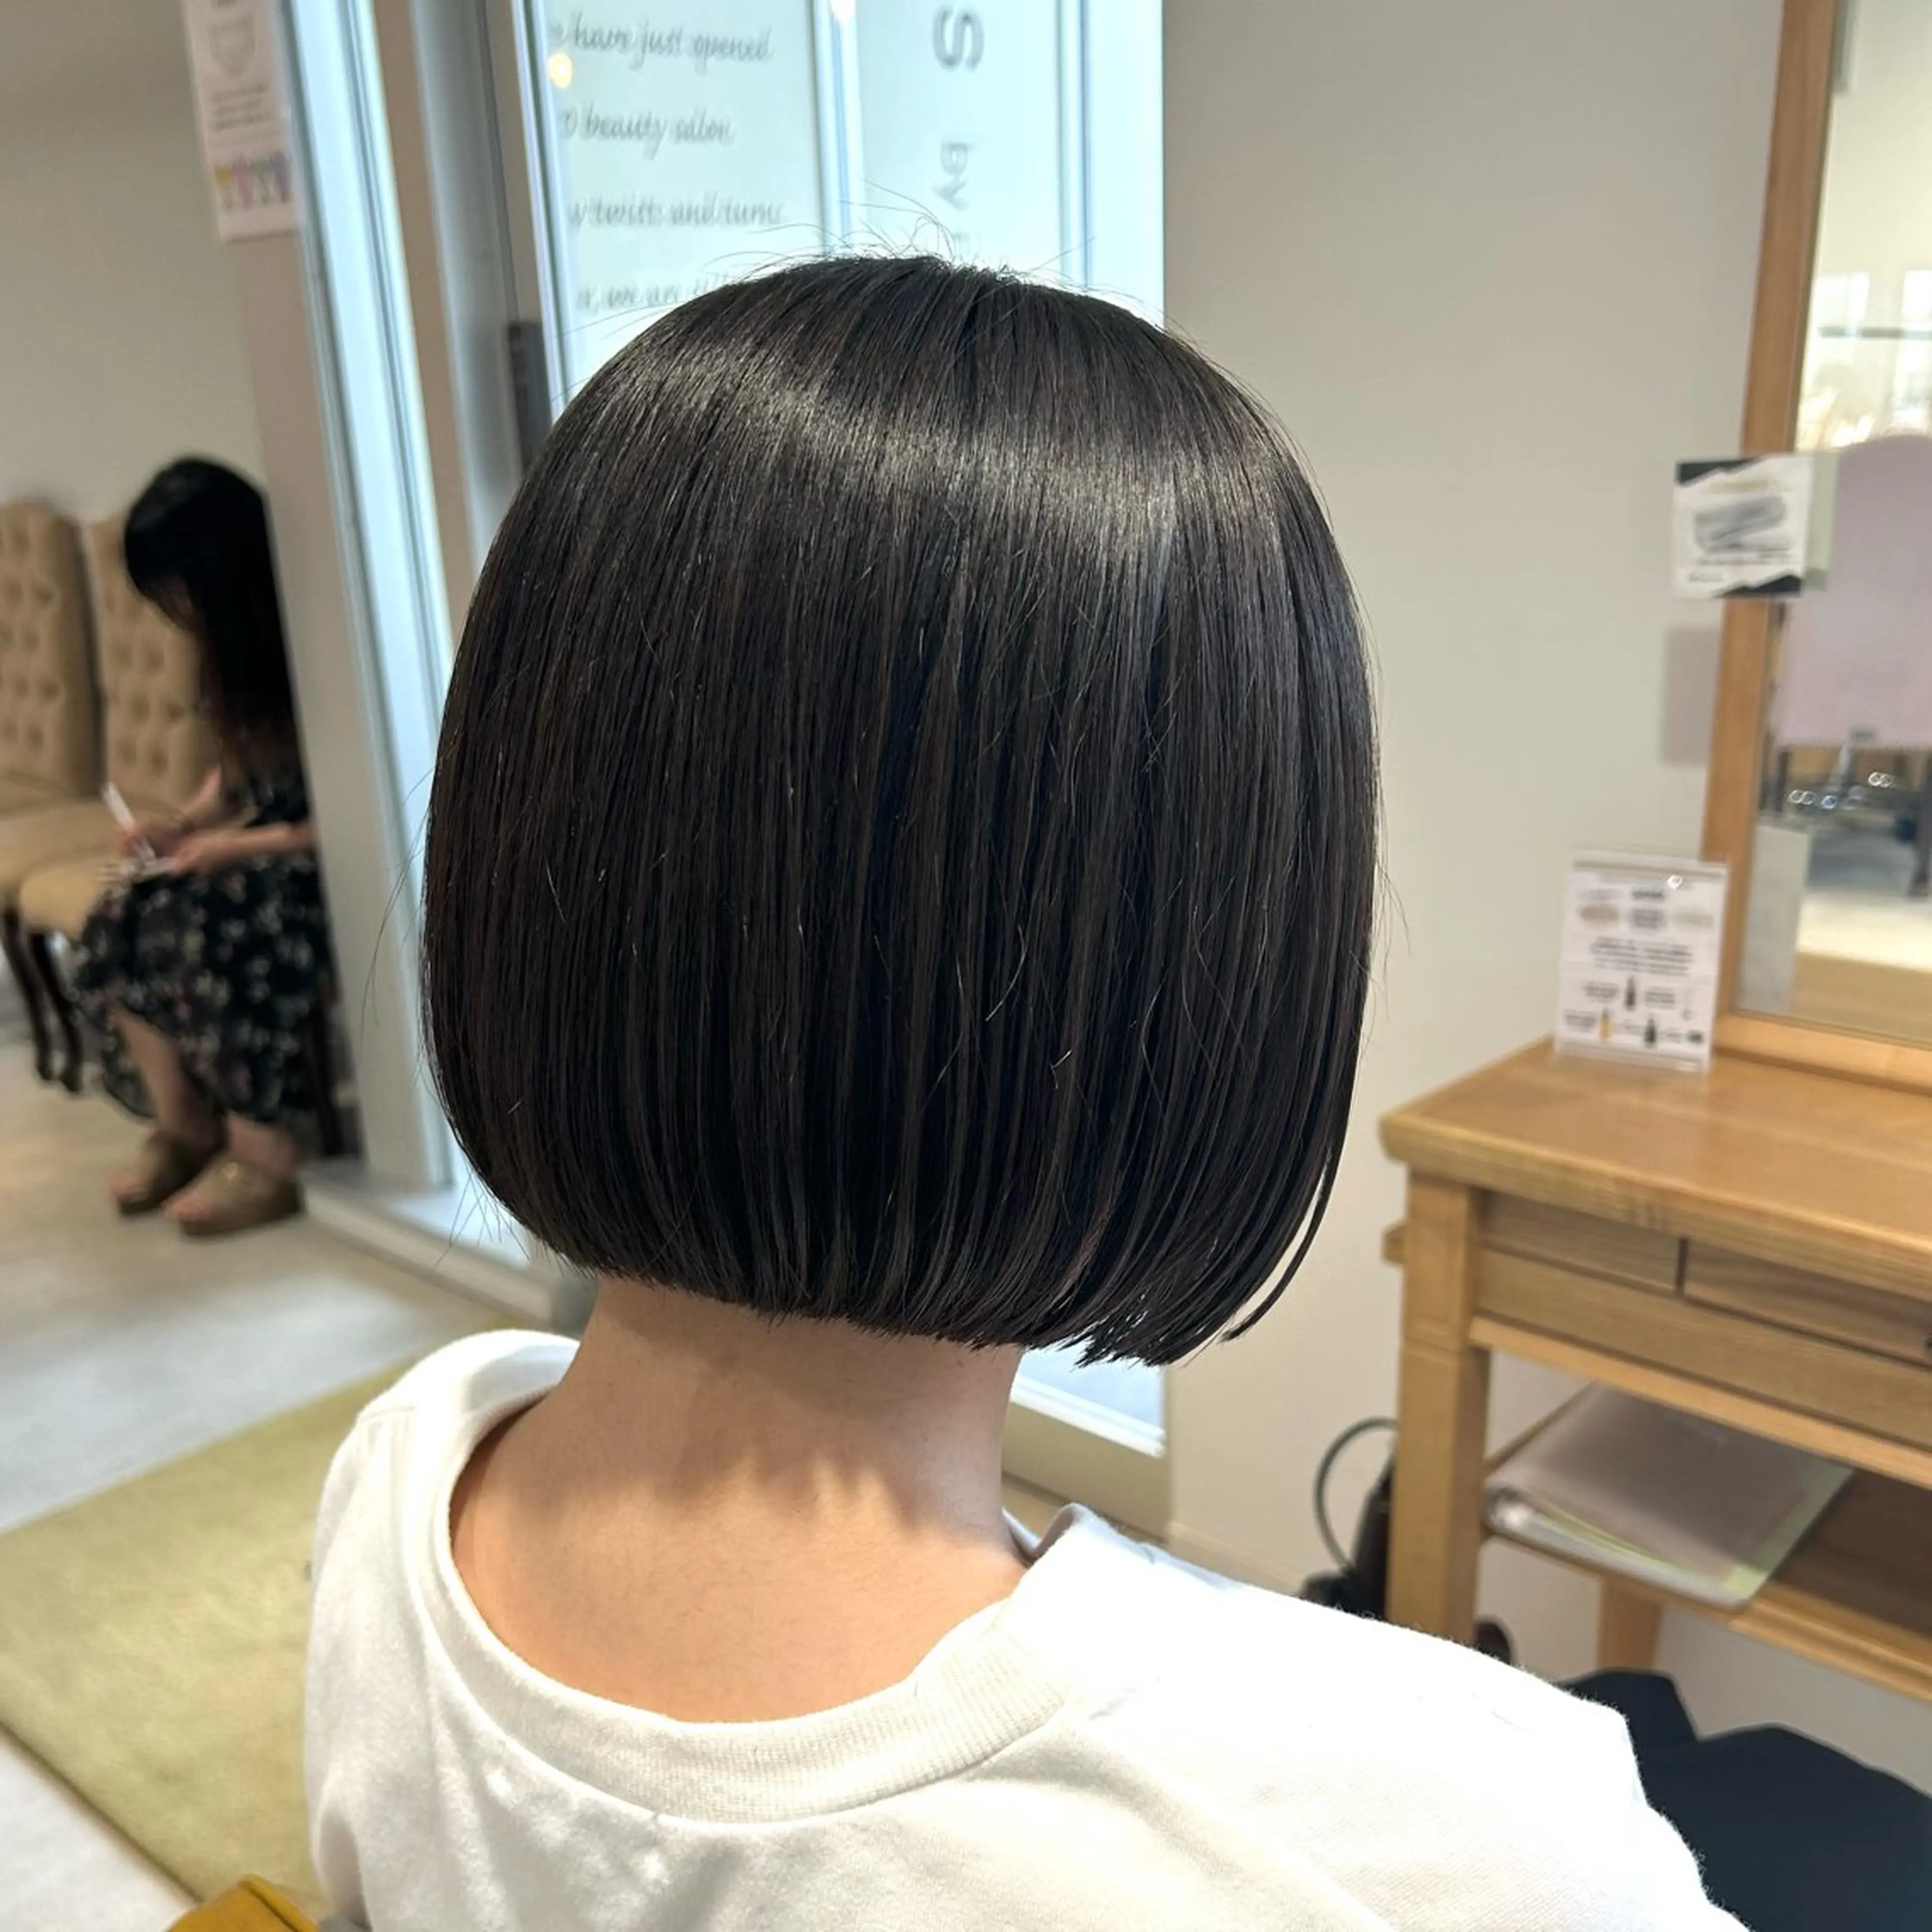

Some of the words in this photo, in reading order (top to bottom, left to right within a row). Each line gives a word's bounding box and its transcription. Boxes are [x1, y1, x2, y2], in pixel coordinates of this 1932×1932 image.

[629, 17, 684, 71] just
[688, 25, 773, 75] opened
[581, 101, 667, 160] beauty
[673, 103, 738, 145] salon
[670, 190, 719, 226] and
